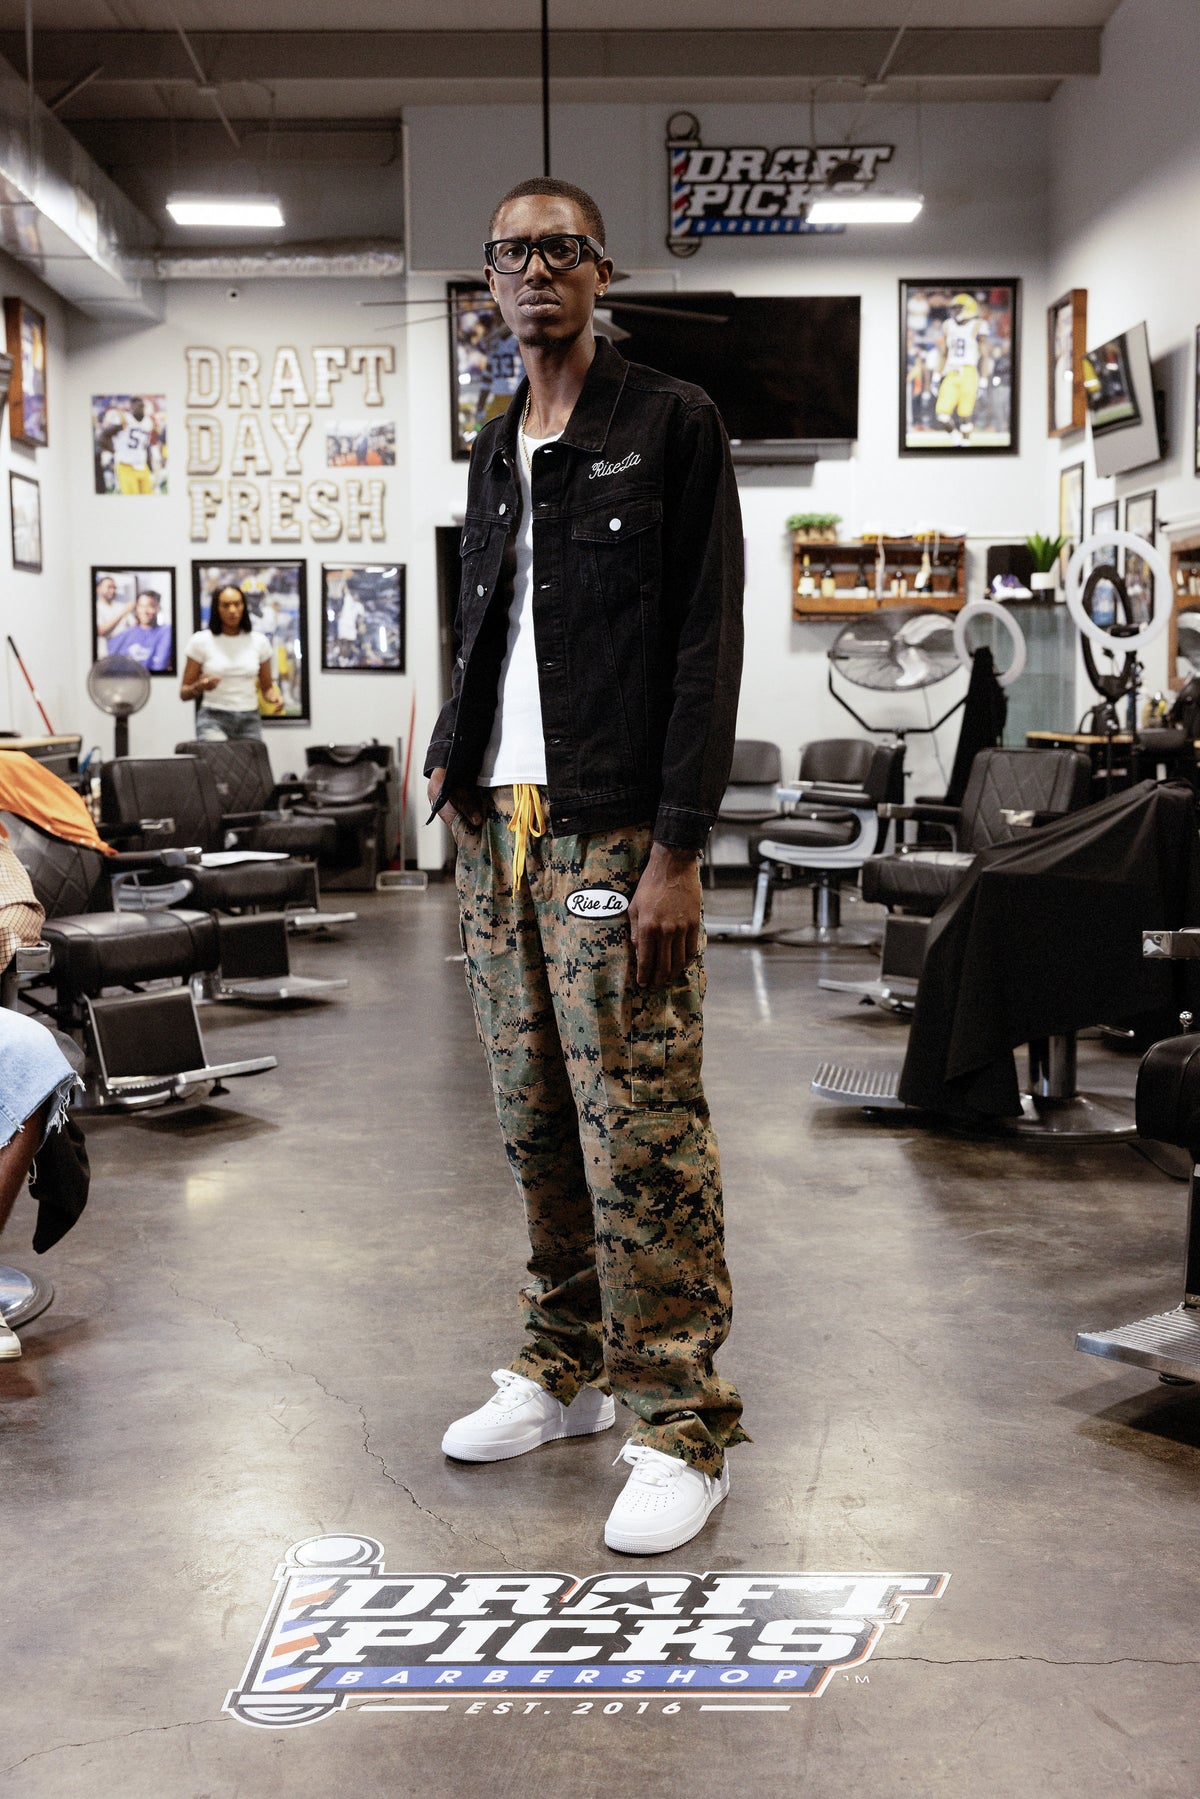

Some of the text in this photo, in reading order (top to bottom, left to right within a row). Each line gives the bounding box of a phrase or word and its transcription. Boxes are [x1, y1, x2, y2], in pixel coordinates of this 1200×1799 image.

[683, 147, 892, 183] DRAFT
[185, 345, 395, 408] DRAFT
[185, 413, 311, 476] DAY
[188, 479, 387, 544] FRESH
[571, 894, 623, 912] Rise La
[309, 1576, 930, 1616] DRAFT
[304, 1618, 857, 1663] PICKS
[335, 1668, 798, 1685] BARBERSHOP
[464, 1701, 684, 1715] EST. 2016
